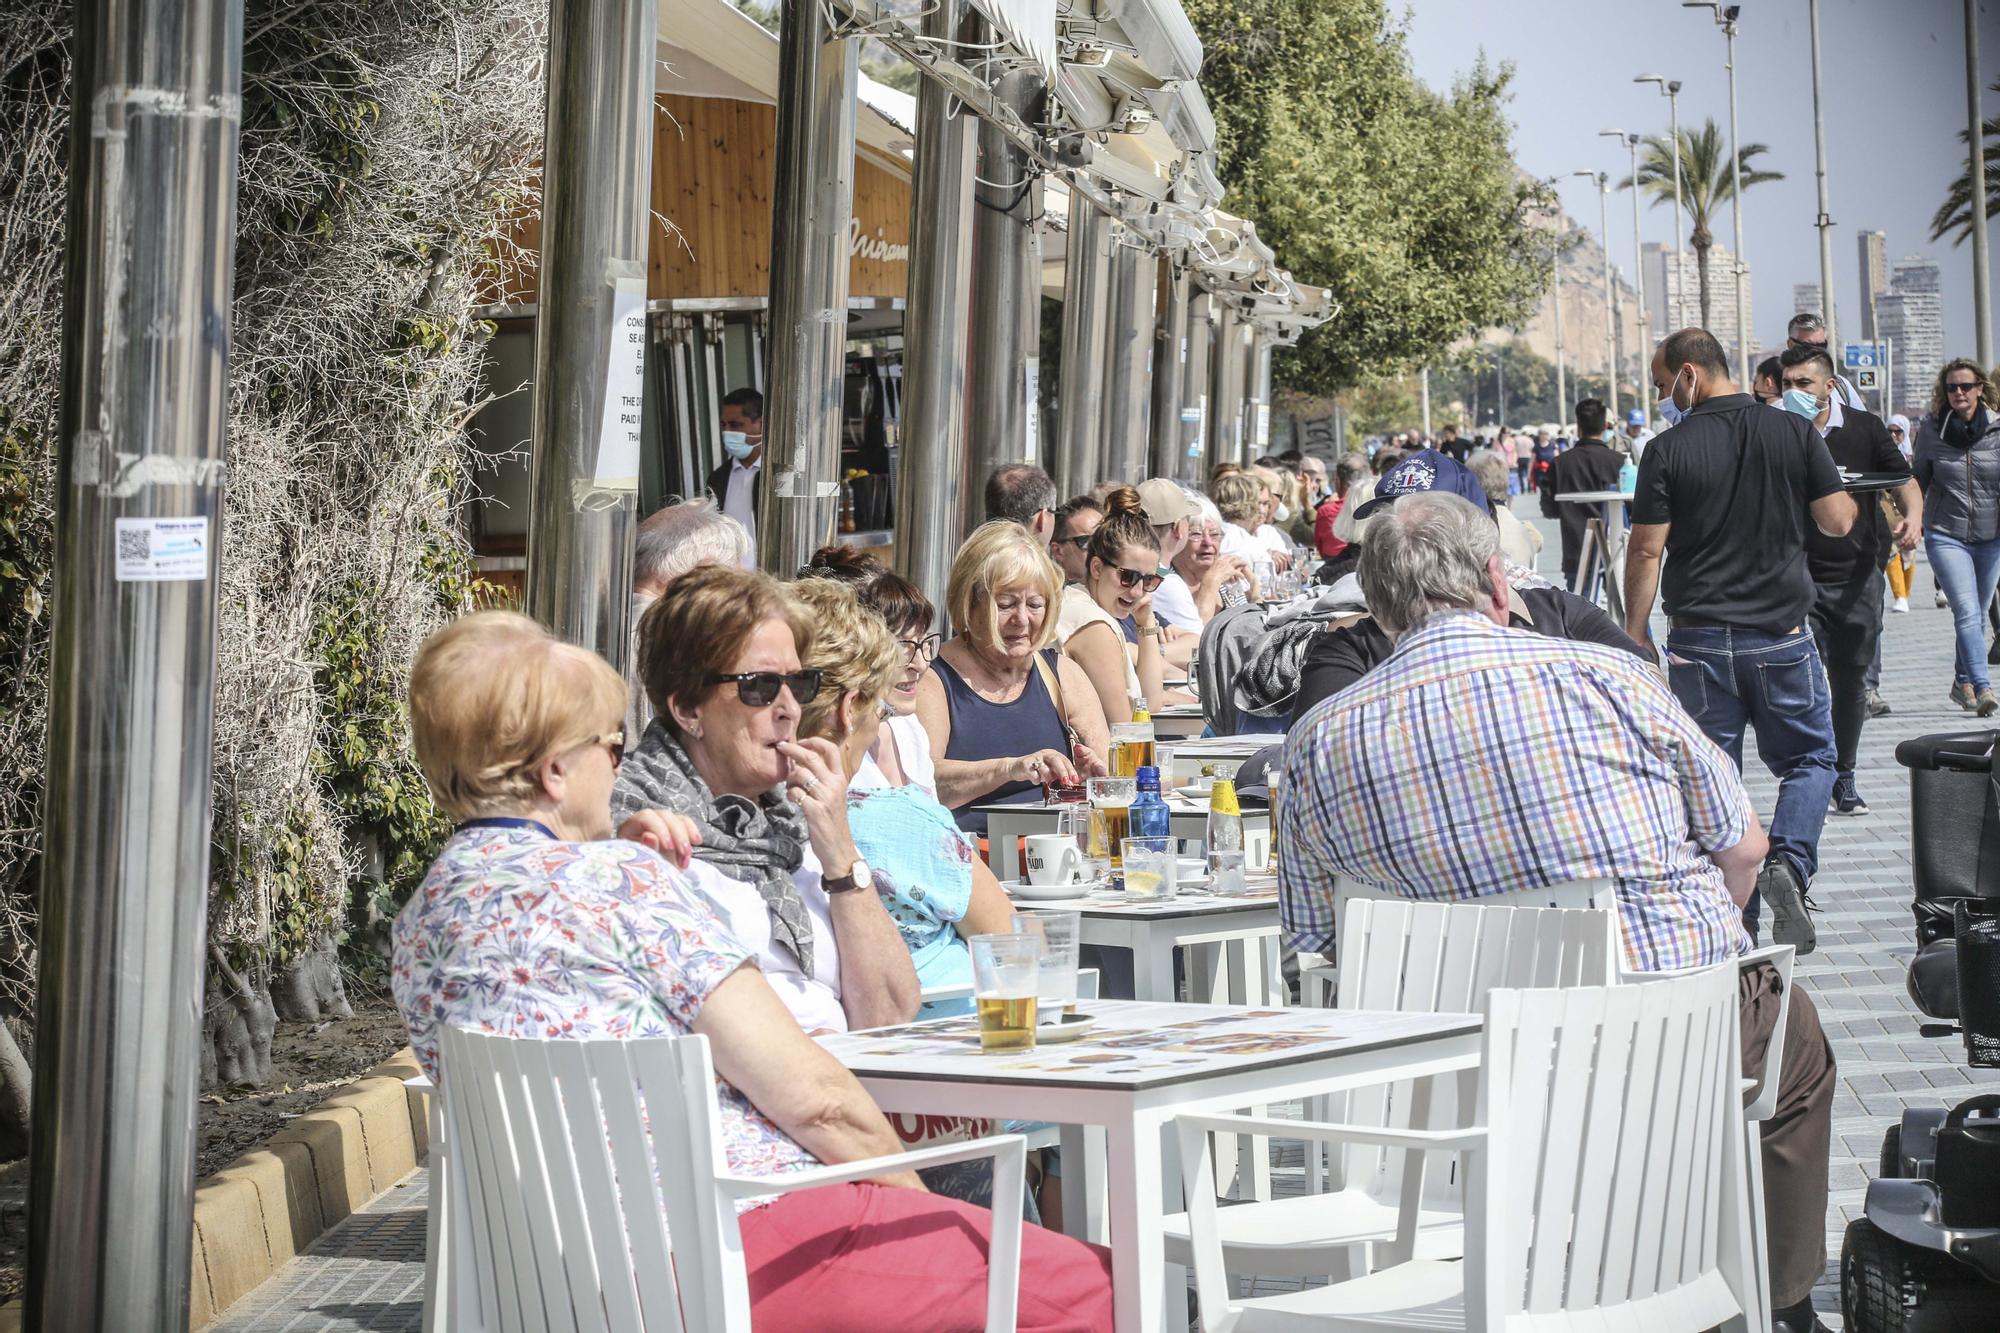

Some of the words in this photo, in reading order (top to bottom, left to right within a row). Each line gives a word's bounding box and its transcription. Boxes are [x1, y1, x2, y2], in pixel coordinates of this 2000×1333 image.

[628, 333, 637, 343] SE
[622, 396, 636, 406] THE
[621, 414, 636, 424] PAID
